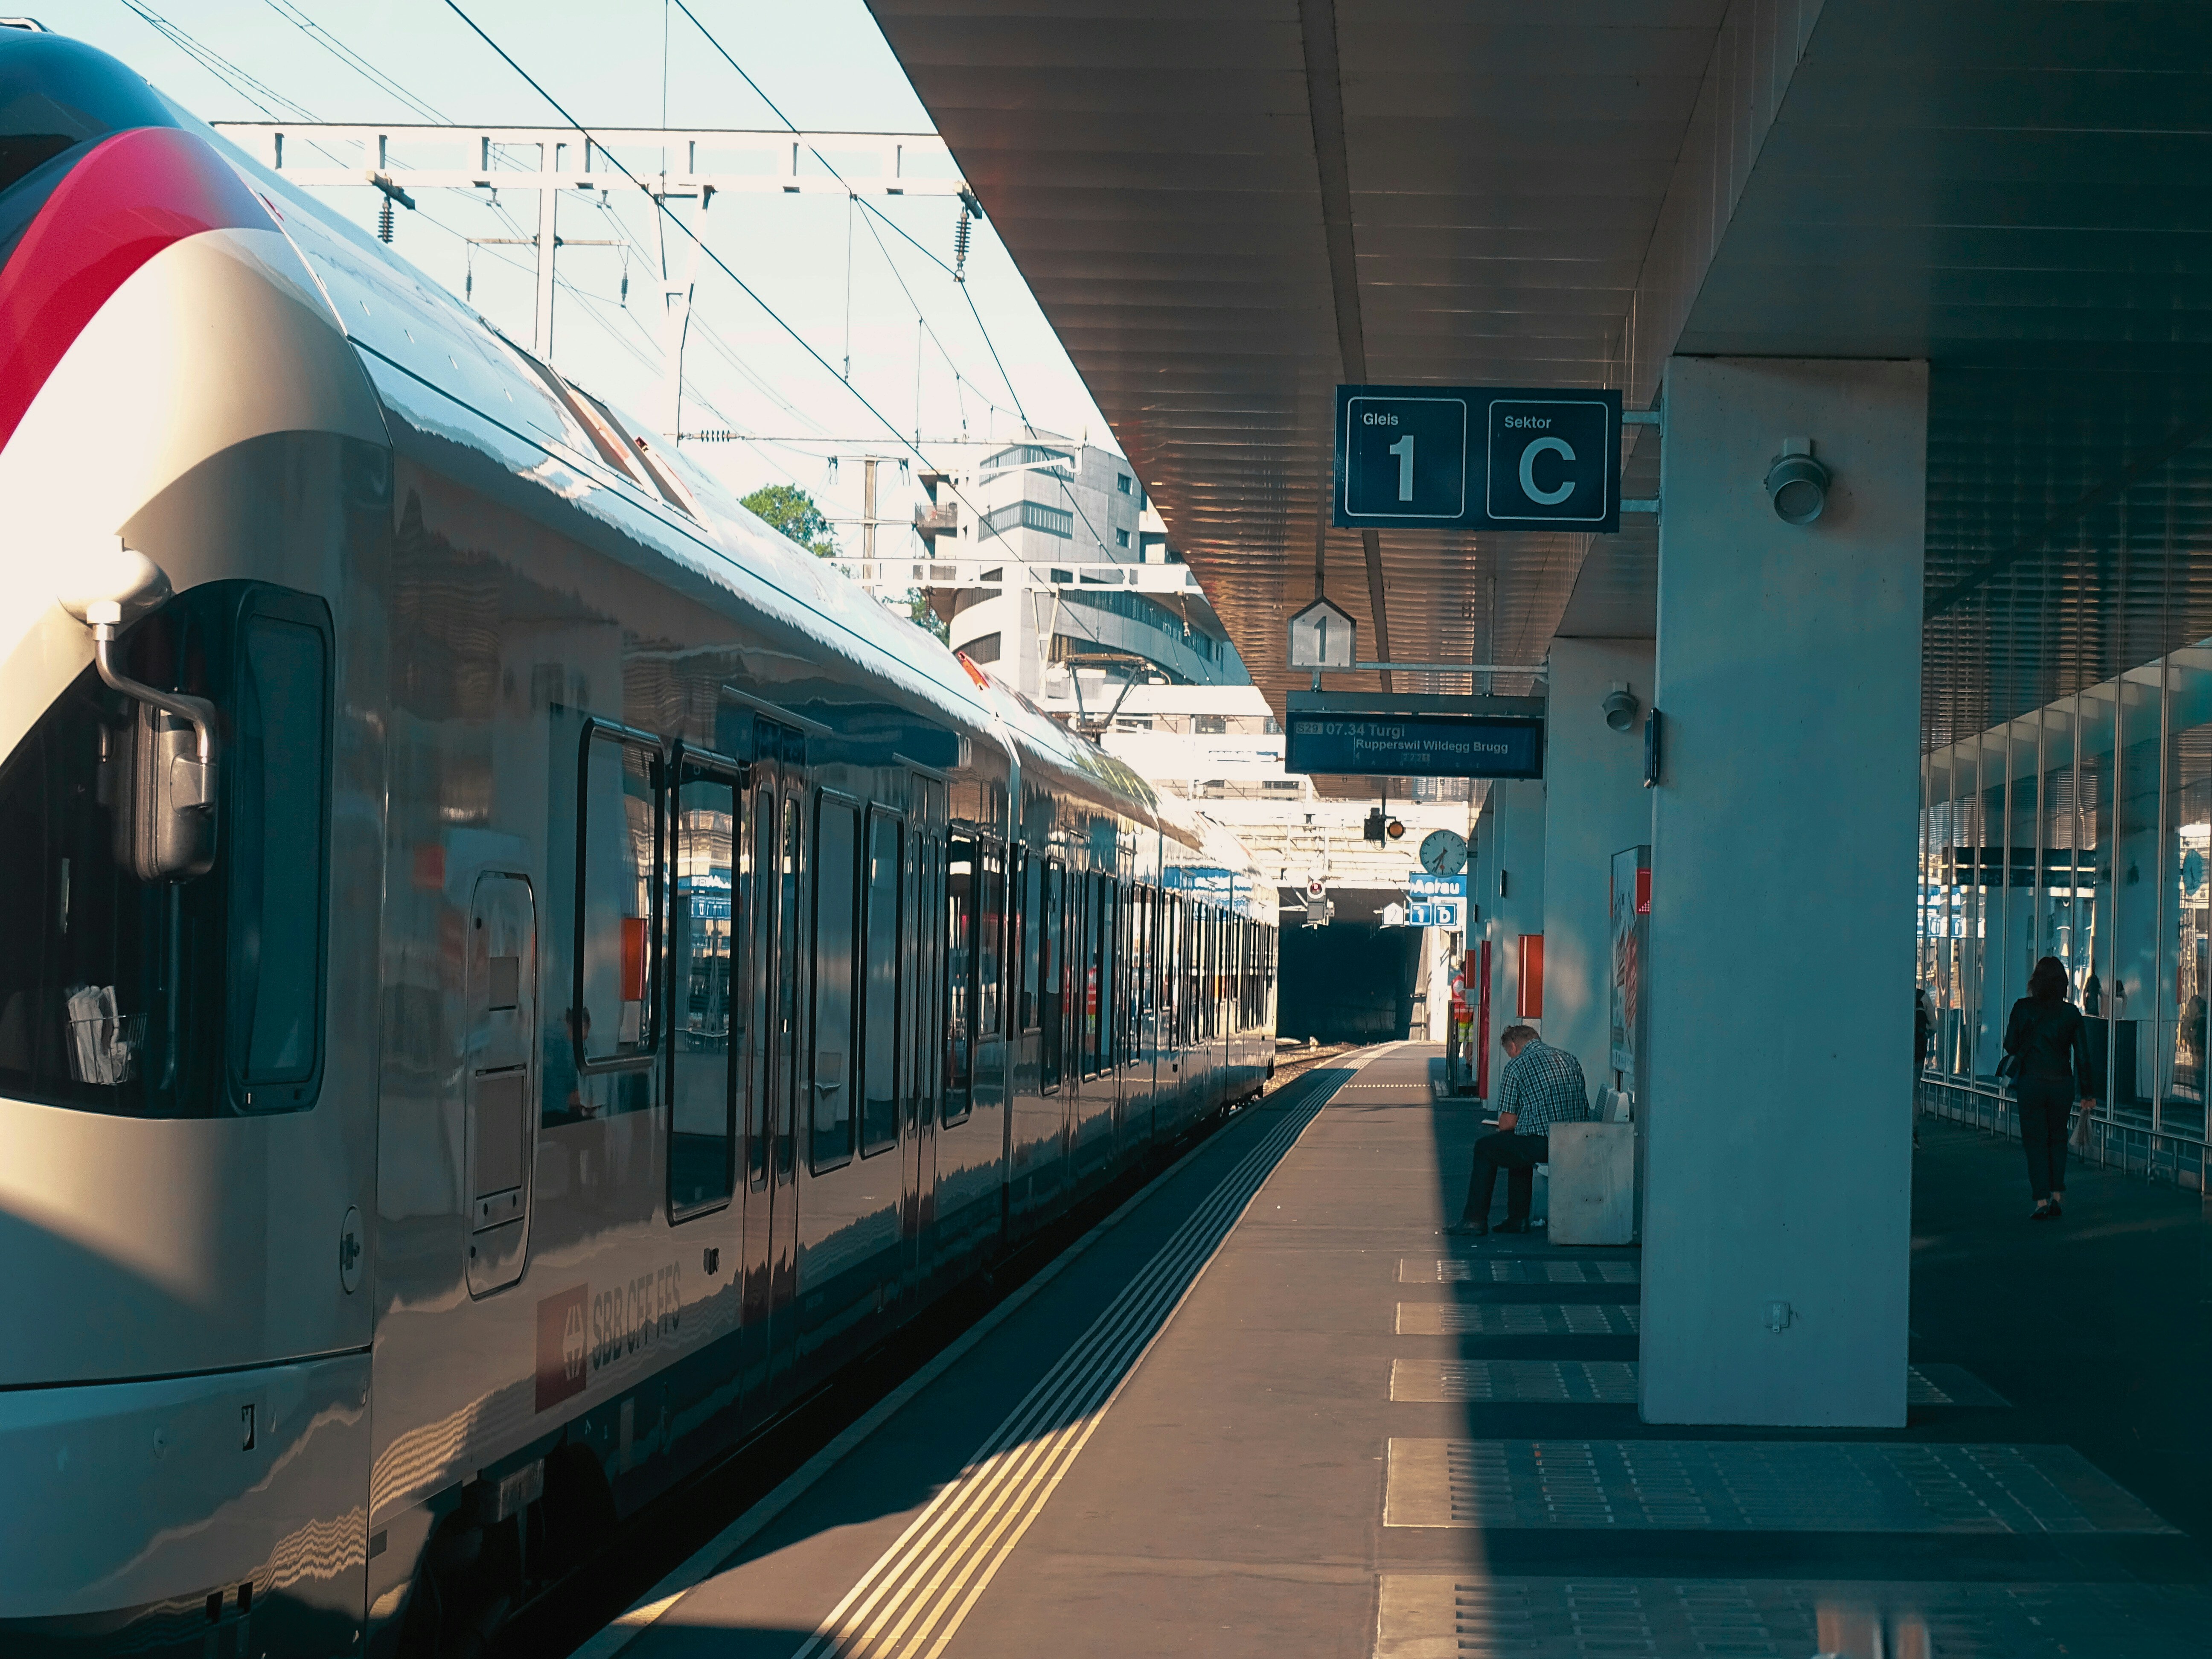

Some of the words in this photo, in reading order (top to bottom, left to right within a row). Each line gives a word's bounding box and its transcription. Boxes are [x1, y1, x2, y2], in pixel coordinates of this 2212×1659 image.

[1363, 413, 1399, 426] Gleis
[1505, 415, 1551, 429] Sektor
[1389, 435, 1415, 501] 1
[1519, 436, 1576, 505] C
[1313, 616, 1327, 662] 1
[1368, 724, 1405, 739] Turgi
[1356, 738, 1420, 751] Rupperswil
[1423, 740, 1470, 754] Wildegg
[1473, 742, 1508, 754] Brugg
[1412, 879, 1460, 894] Aarau
[1417, 908, 1424, 923] 1
[1439, 909, 1451, 923] D
[593, 1287, 623, 1370] SBB
[627, 1273, 654, 1354] CFF
[657, 1261, 680, 1338] FFS
